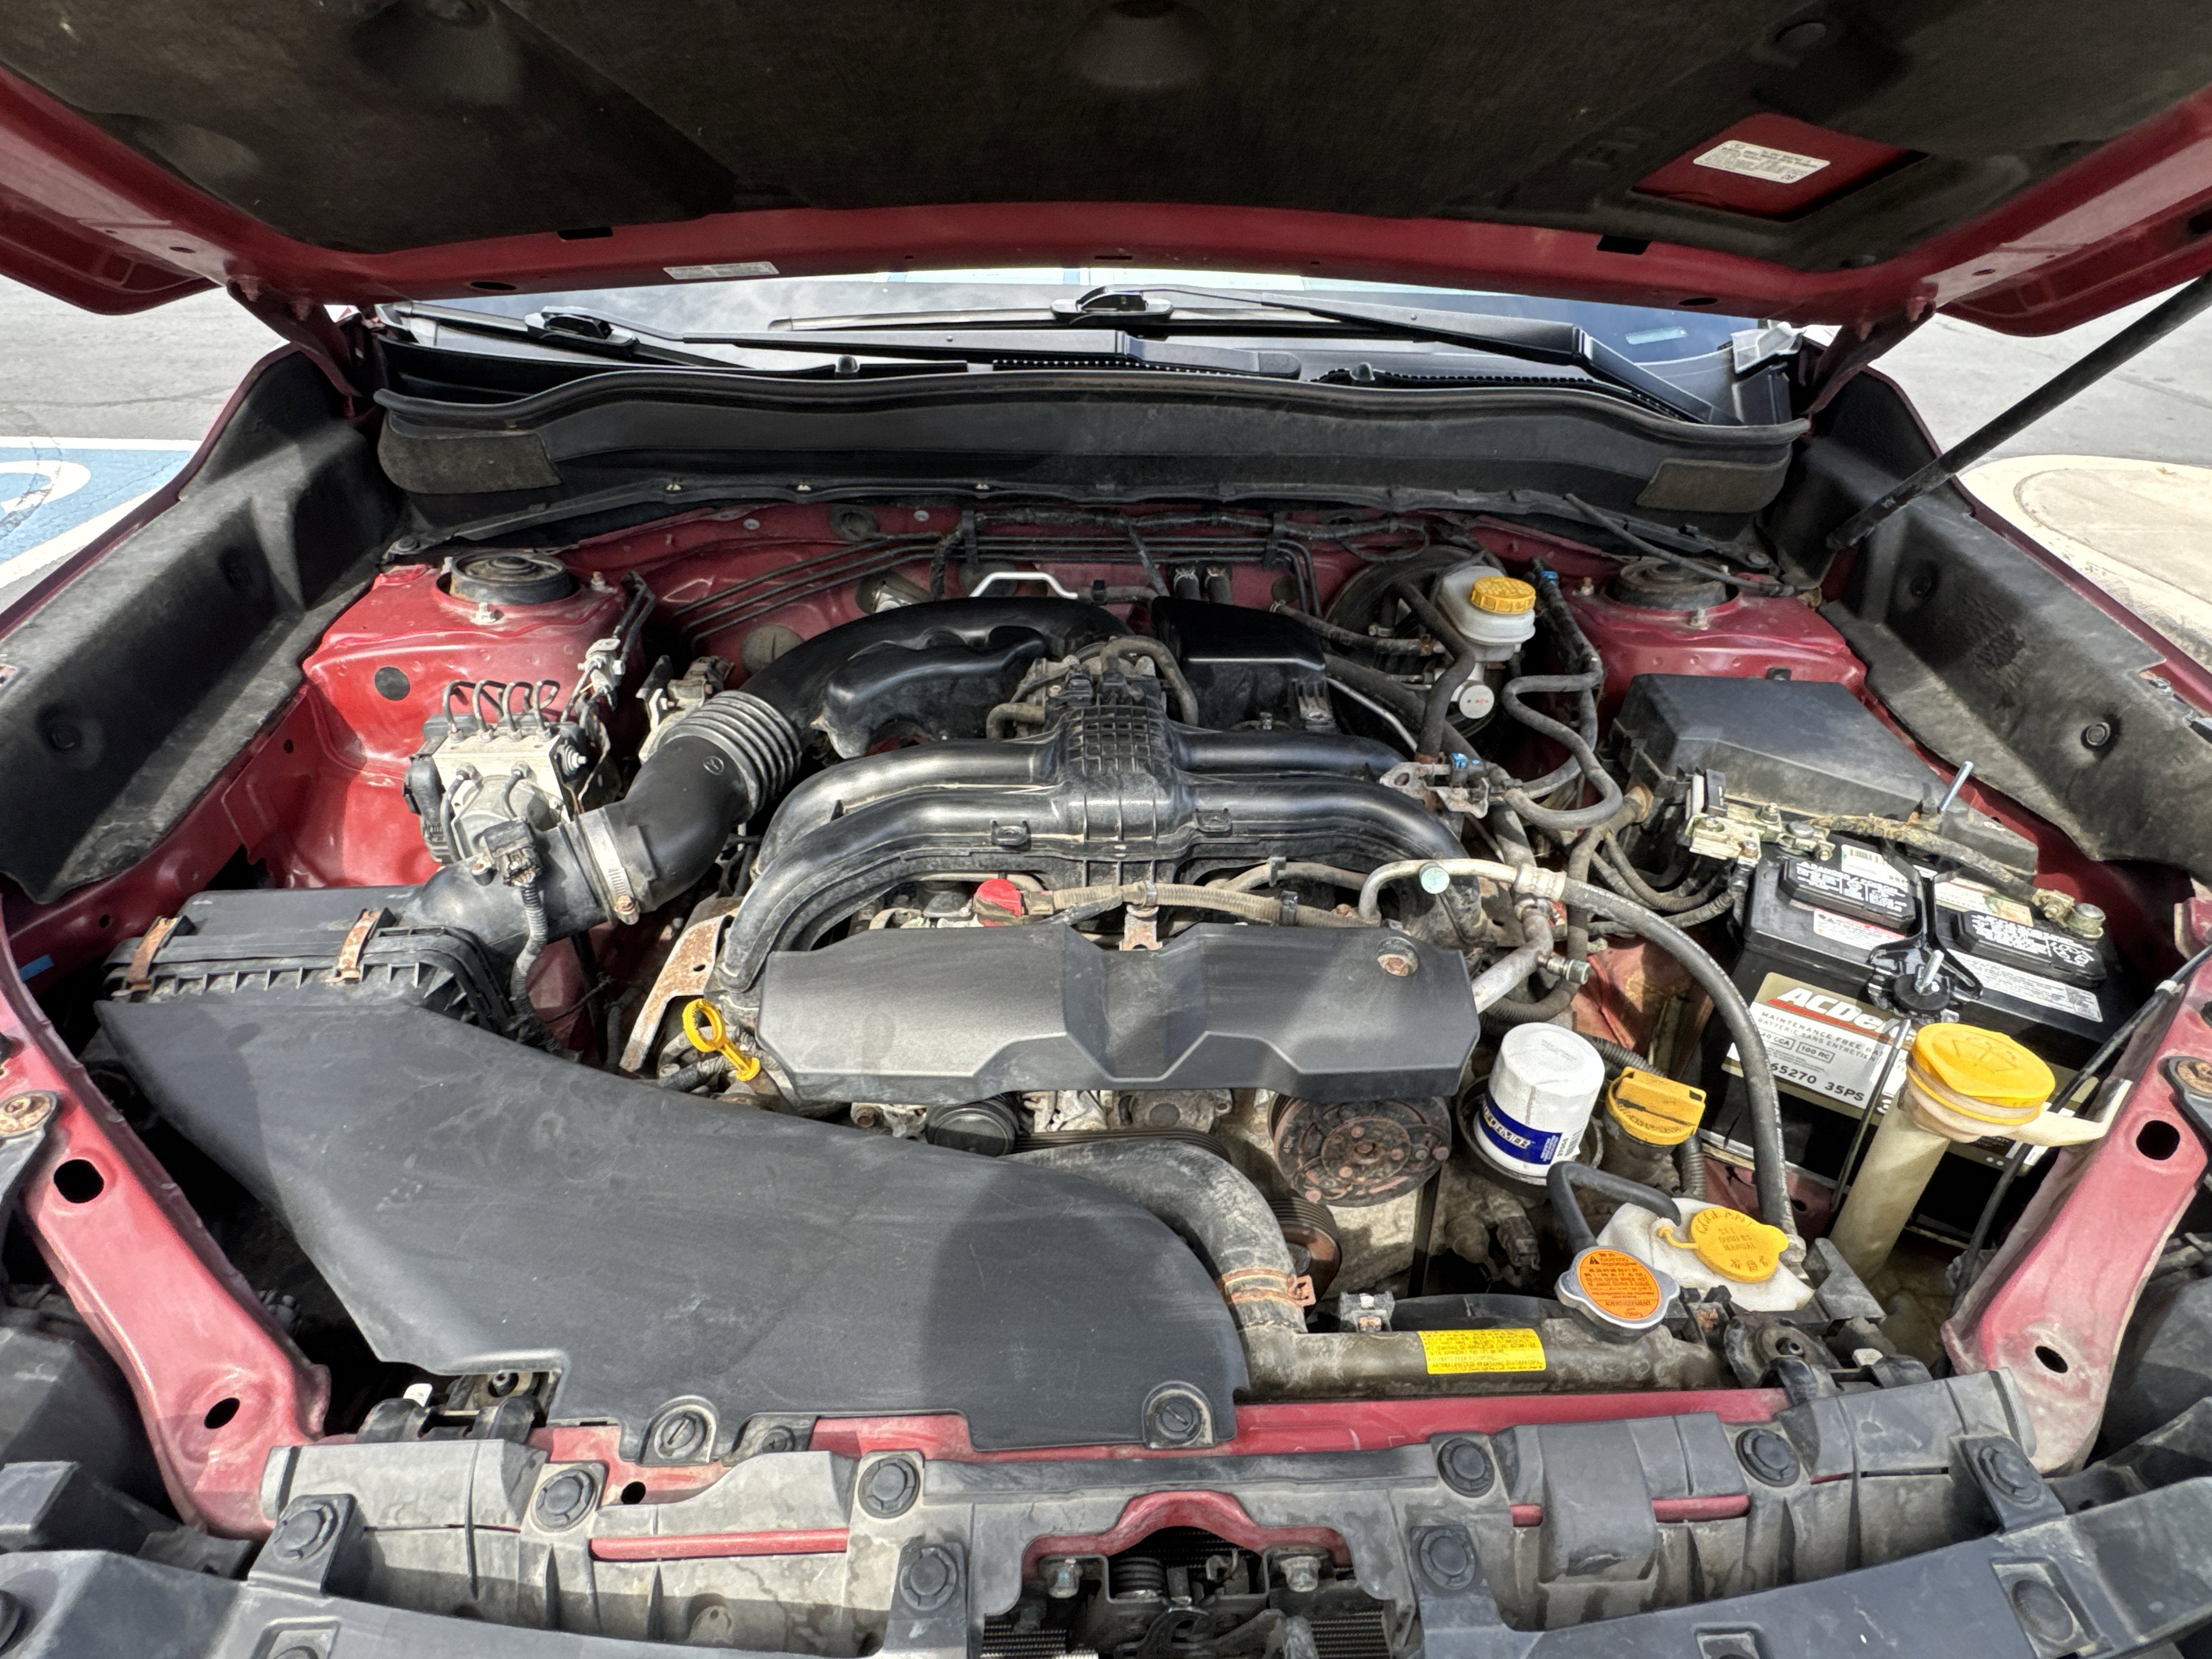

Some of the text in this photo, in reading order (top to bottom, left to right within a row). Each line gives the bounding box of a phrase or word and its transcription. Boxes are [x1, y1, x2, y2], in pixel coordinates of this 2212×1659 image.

[1776, 987, 1916, 1042] ACDel
[1757, 1018, 1796, 1037] BATTERIE
[1801, 1032, 1824, 1045] SANS
[1762, 1011, 1833, 1039] MAINTENANCE
[1835, 1035, 1862, 1050] FREE
[1774, 1036, 1790, 1047] CCA
[1801, 1046, 1831, 1061] 100 RC
[1825, 1081, 1865, 1101] 35PS
[1695, 1210, 1753, 1234] COOLANT
